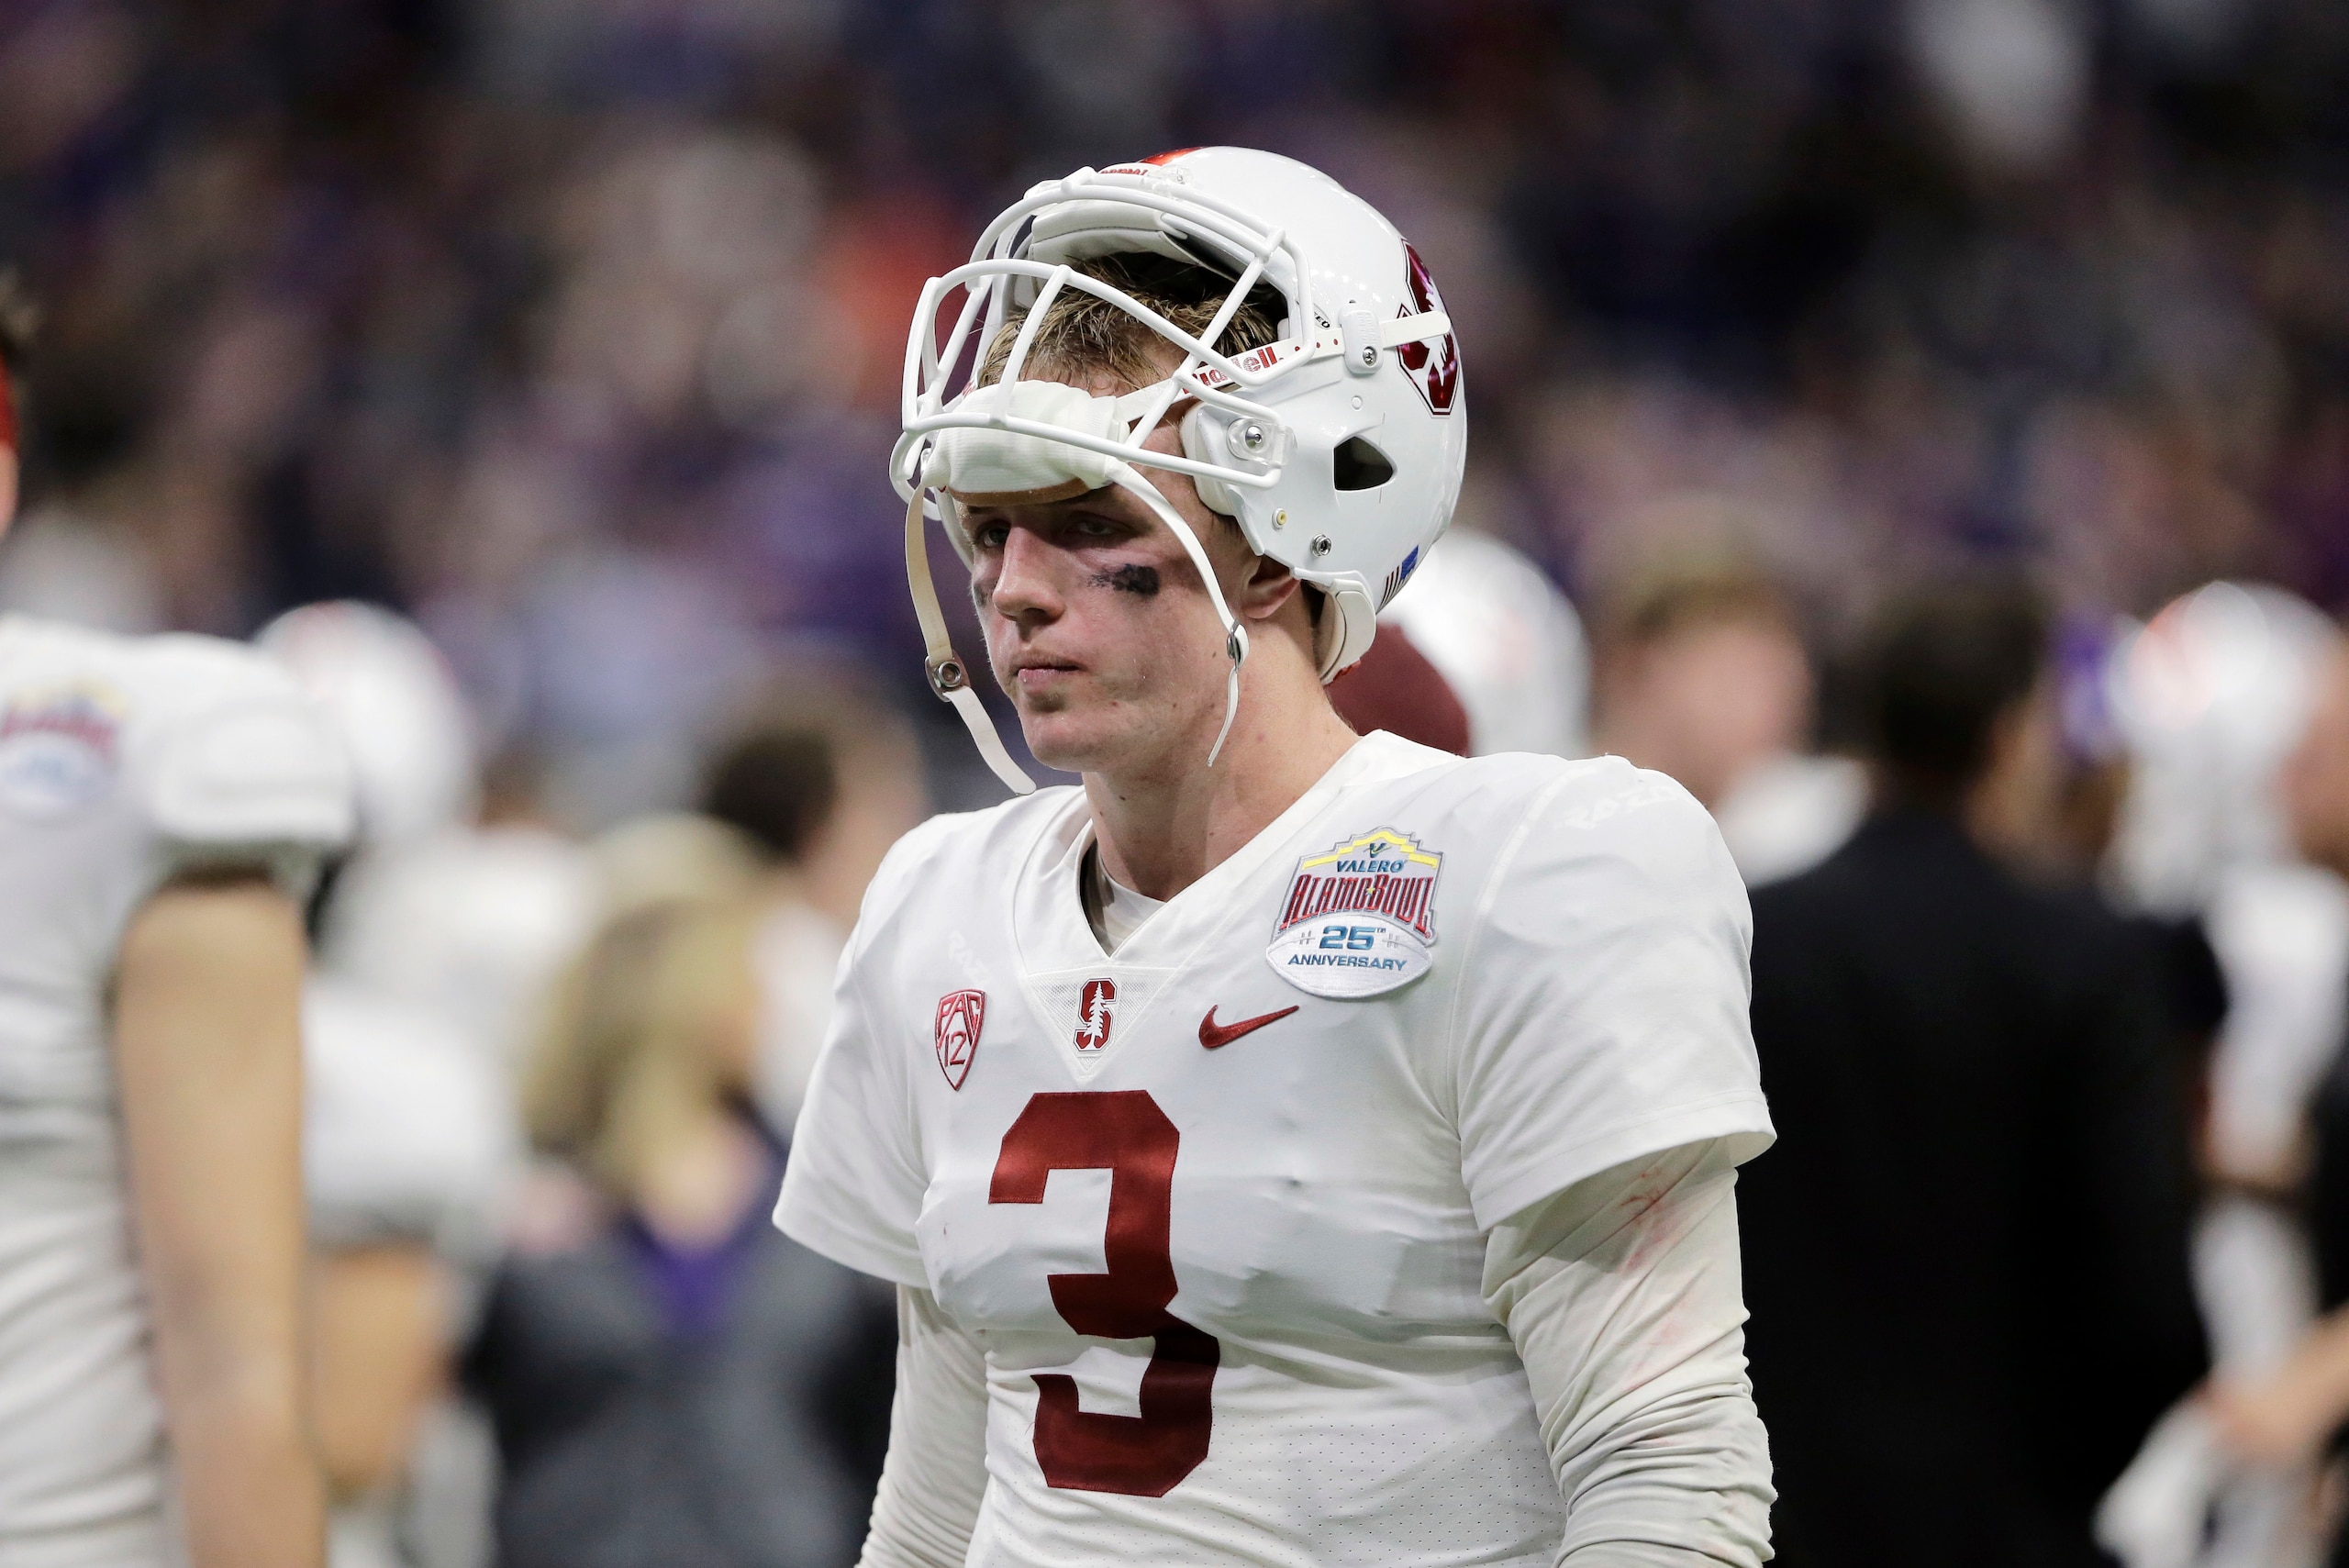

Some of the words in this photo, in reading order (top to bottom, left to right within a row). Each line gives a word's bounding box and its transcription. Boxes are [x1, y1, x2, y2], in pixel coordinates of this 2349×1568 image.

[1337, 859, 1406, 873] VALERO
[1287, 953, 1408, 972] ANNIVERSARY
[937, 993, 981, 1051] PAC
[944, 1030, 967, 1068] 12
[988, 1089, 1220, 1498] 3
